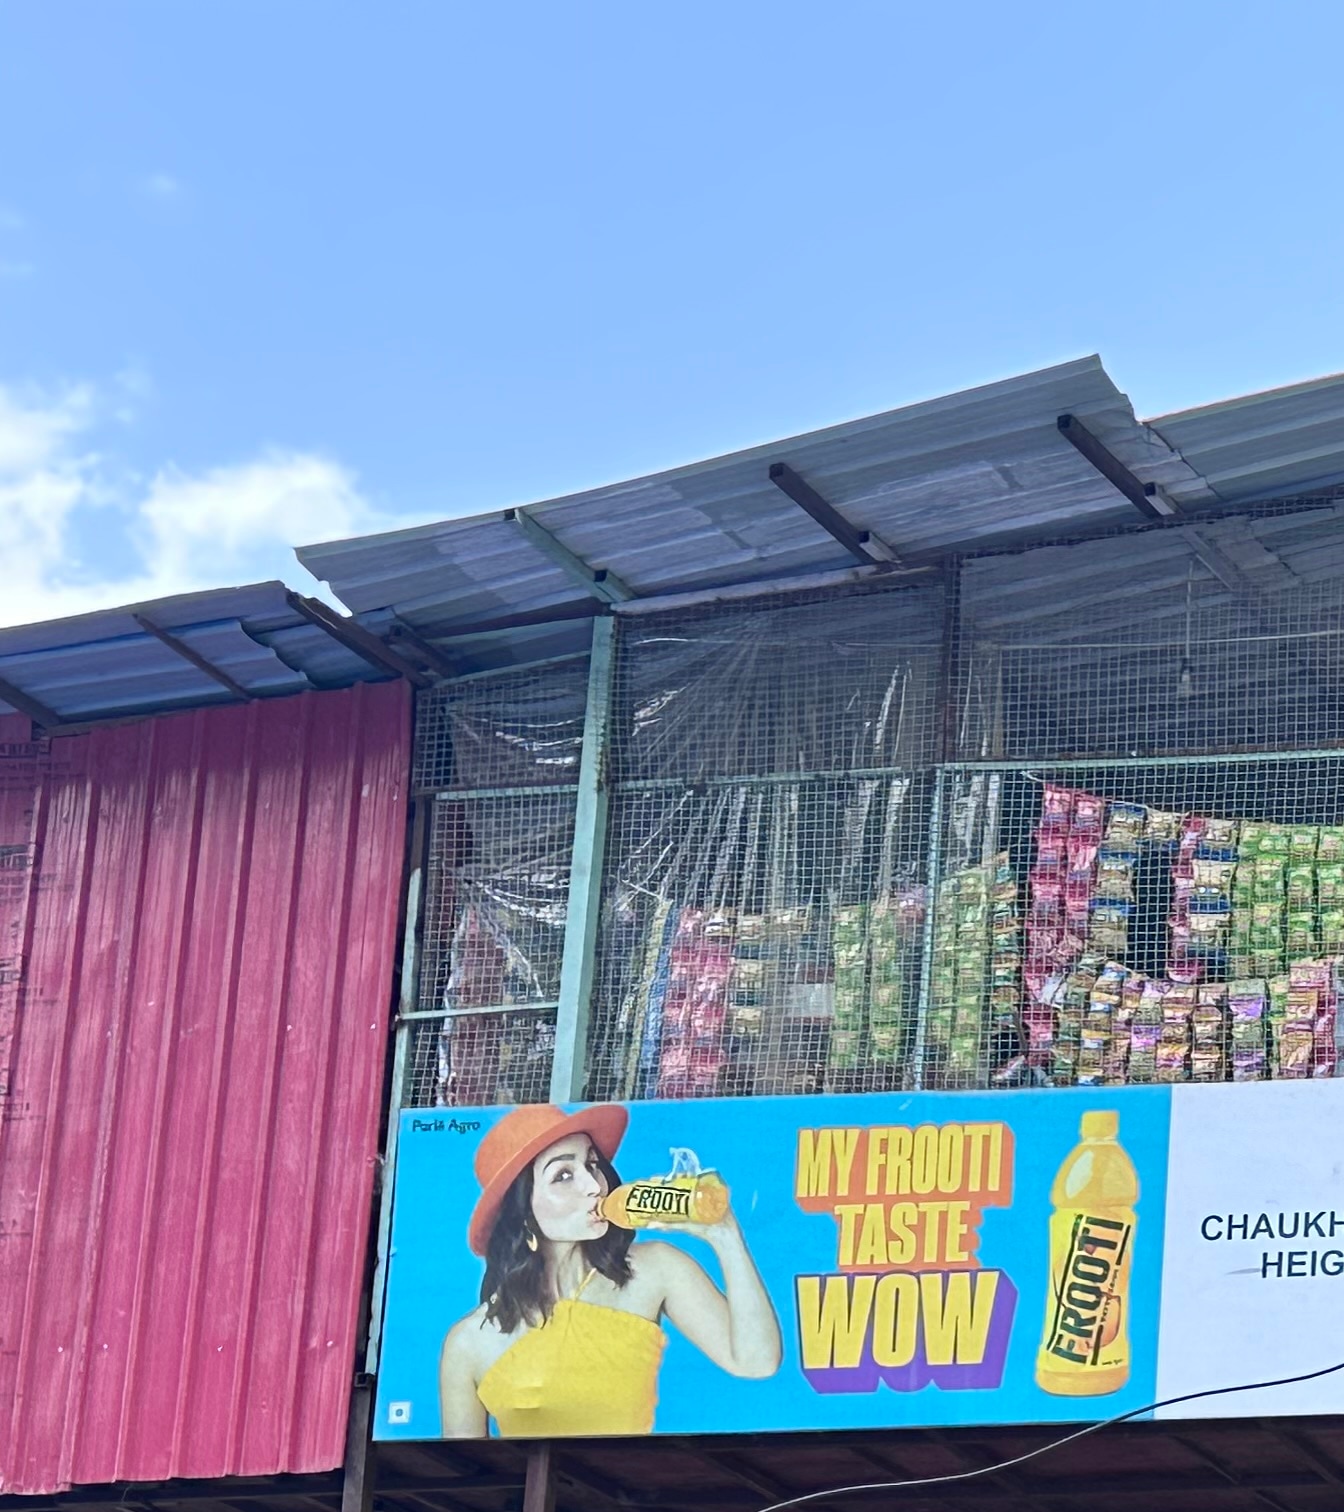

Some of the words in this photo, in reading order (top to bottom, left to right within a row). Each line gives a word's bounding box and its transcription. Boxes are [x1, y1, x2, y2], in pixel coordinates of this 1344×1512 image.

[448, 1118, 481, 1135] Agro
[796, 1127, 861, 1198] MY
[865, 1122, 1004, 1196] FROOTI
[834, 1200, 971, 1266] TASTE
[796, 1270, 1001, 1370] WOW
[1051, 1216, 1125, 1365] FROOTI
